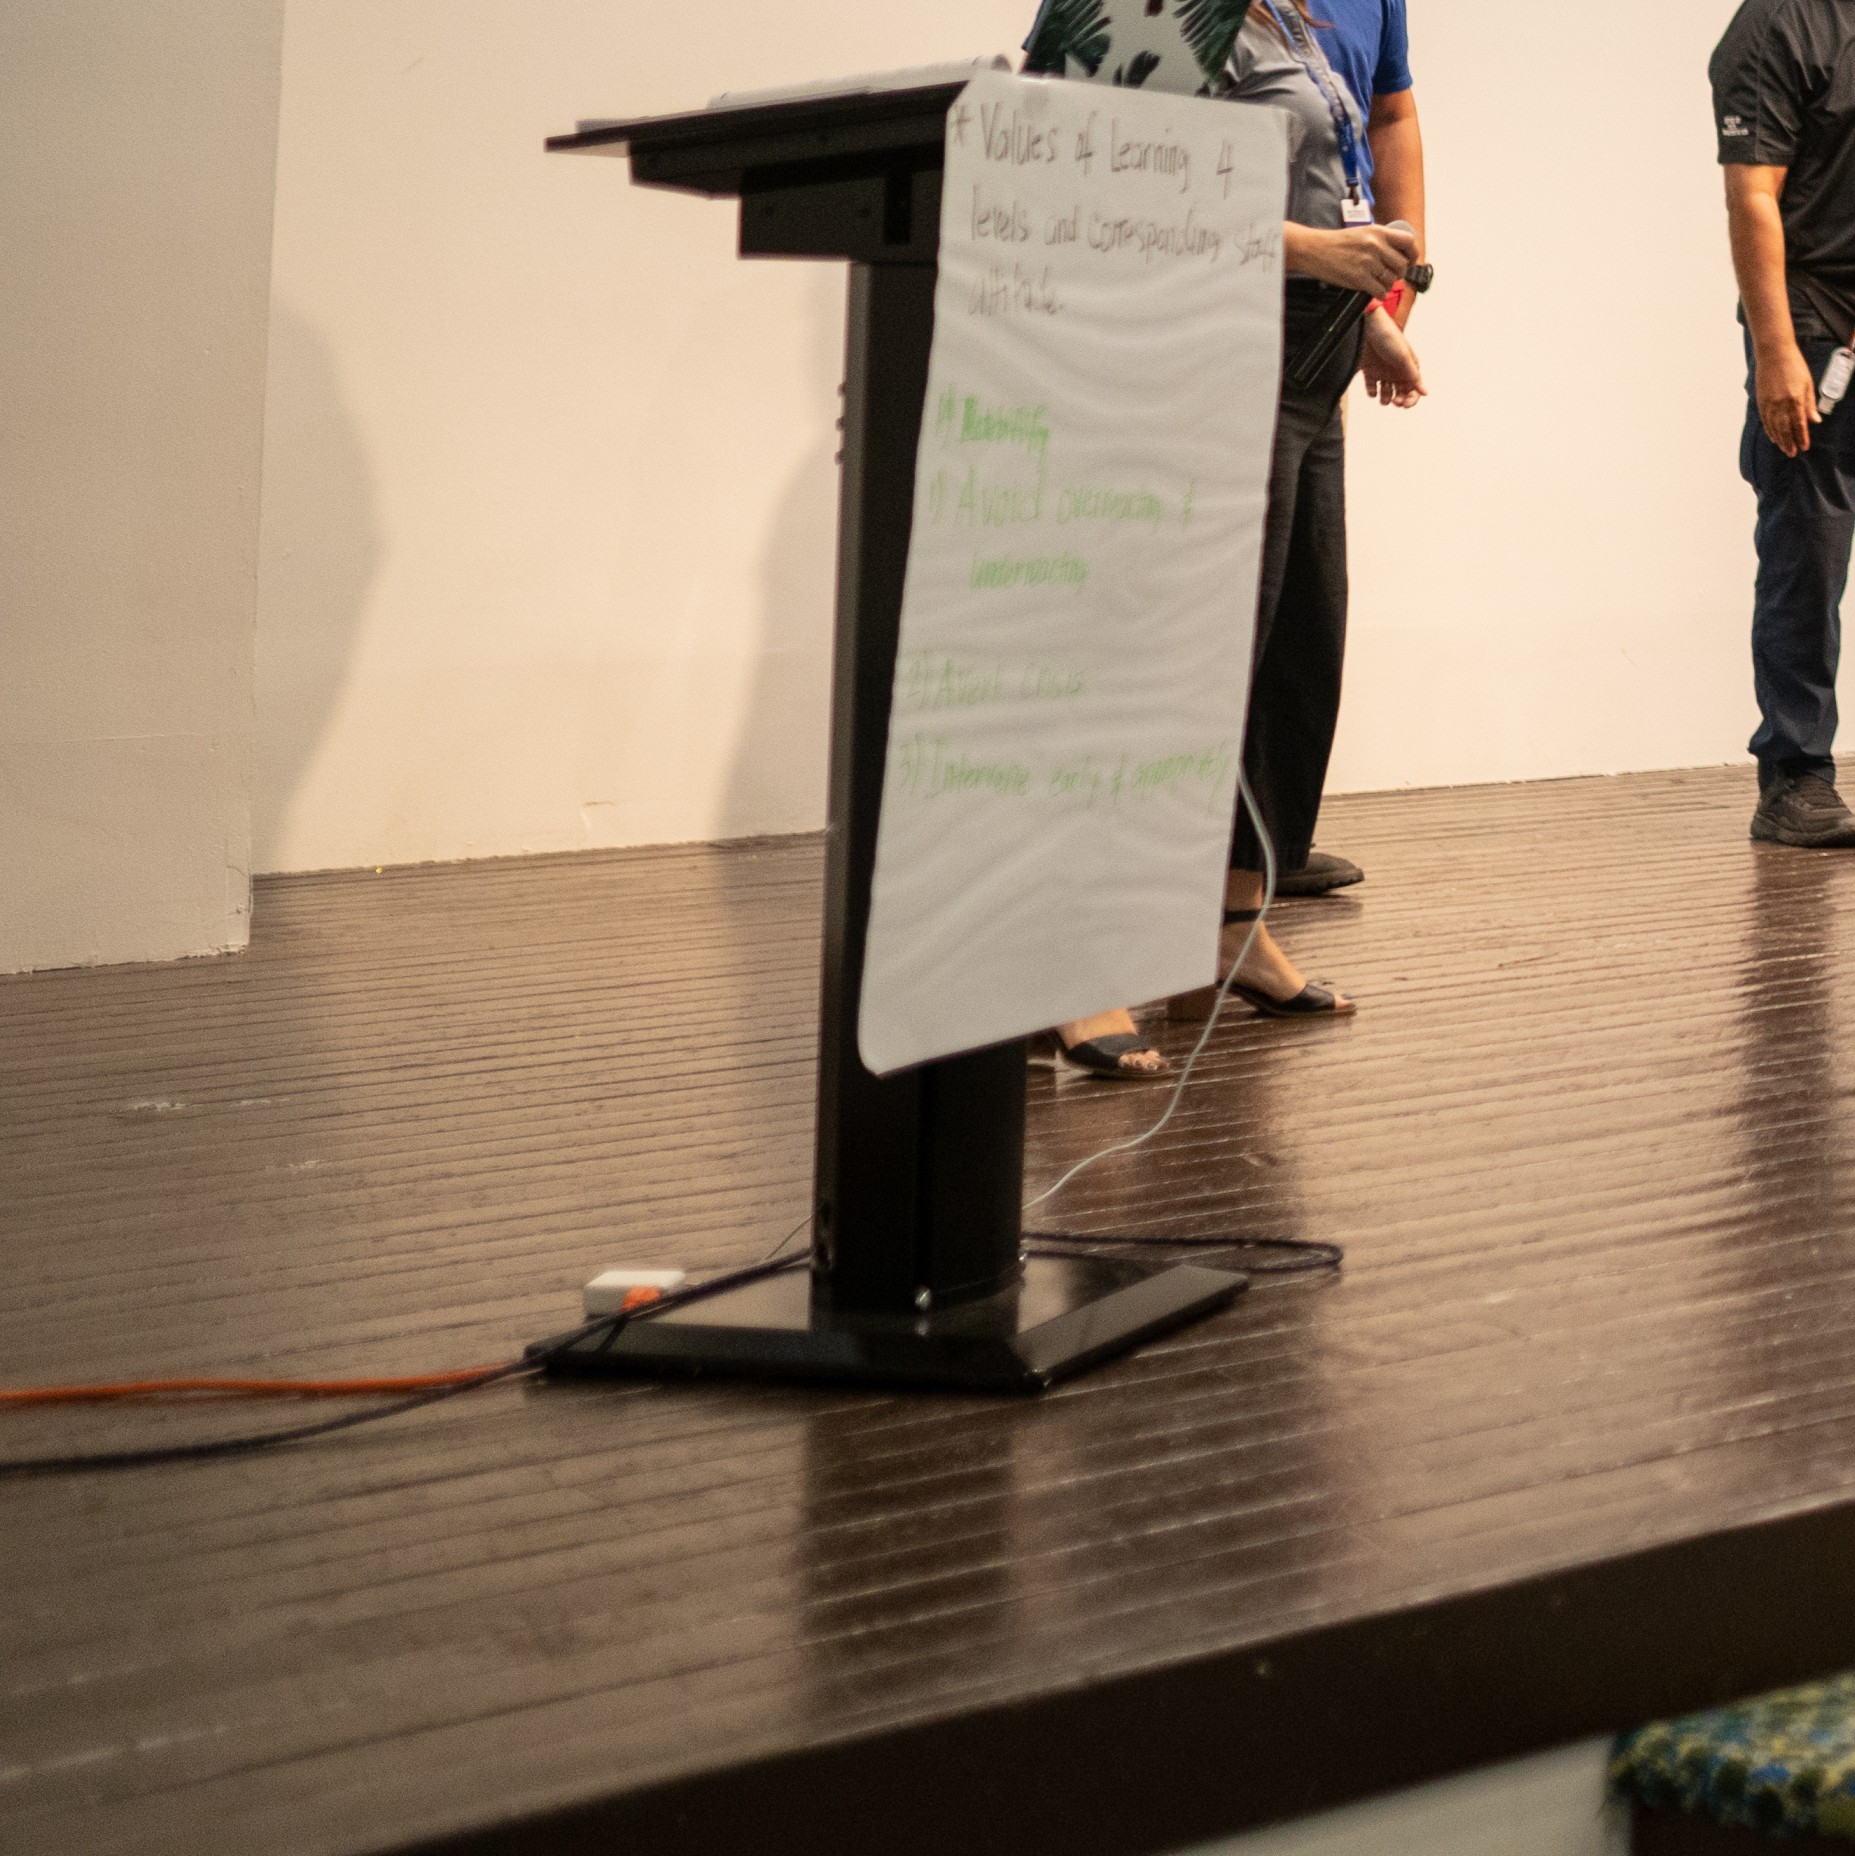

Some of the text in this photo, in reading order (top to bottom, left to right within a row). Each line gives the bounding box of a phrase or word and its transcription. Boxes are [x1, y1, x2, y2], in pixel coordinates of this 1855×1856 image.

[980, 101, 1059, 165] Values
[1075, 110, 1096, 176] of
[1110, 117, 1191, 193] Learning
[1045, 205, 1079, 245] and
